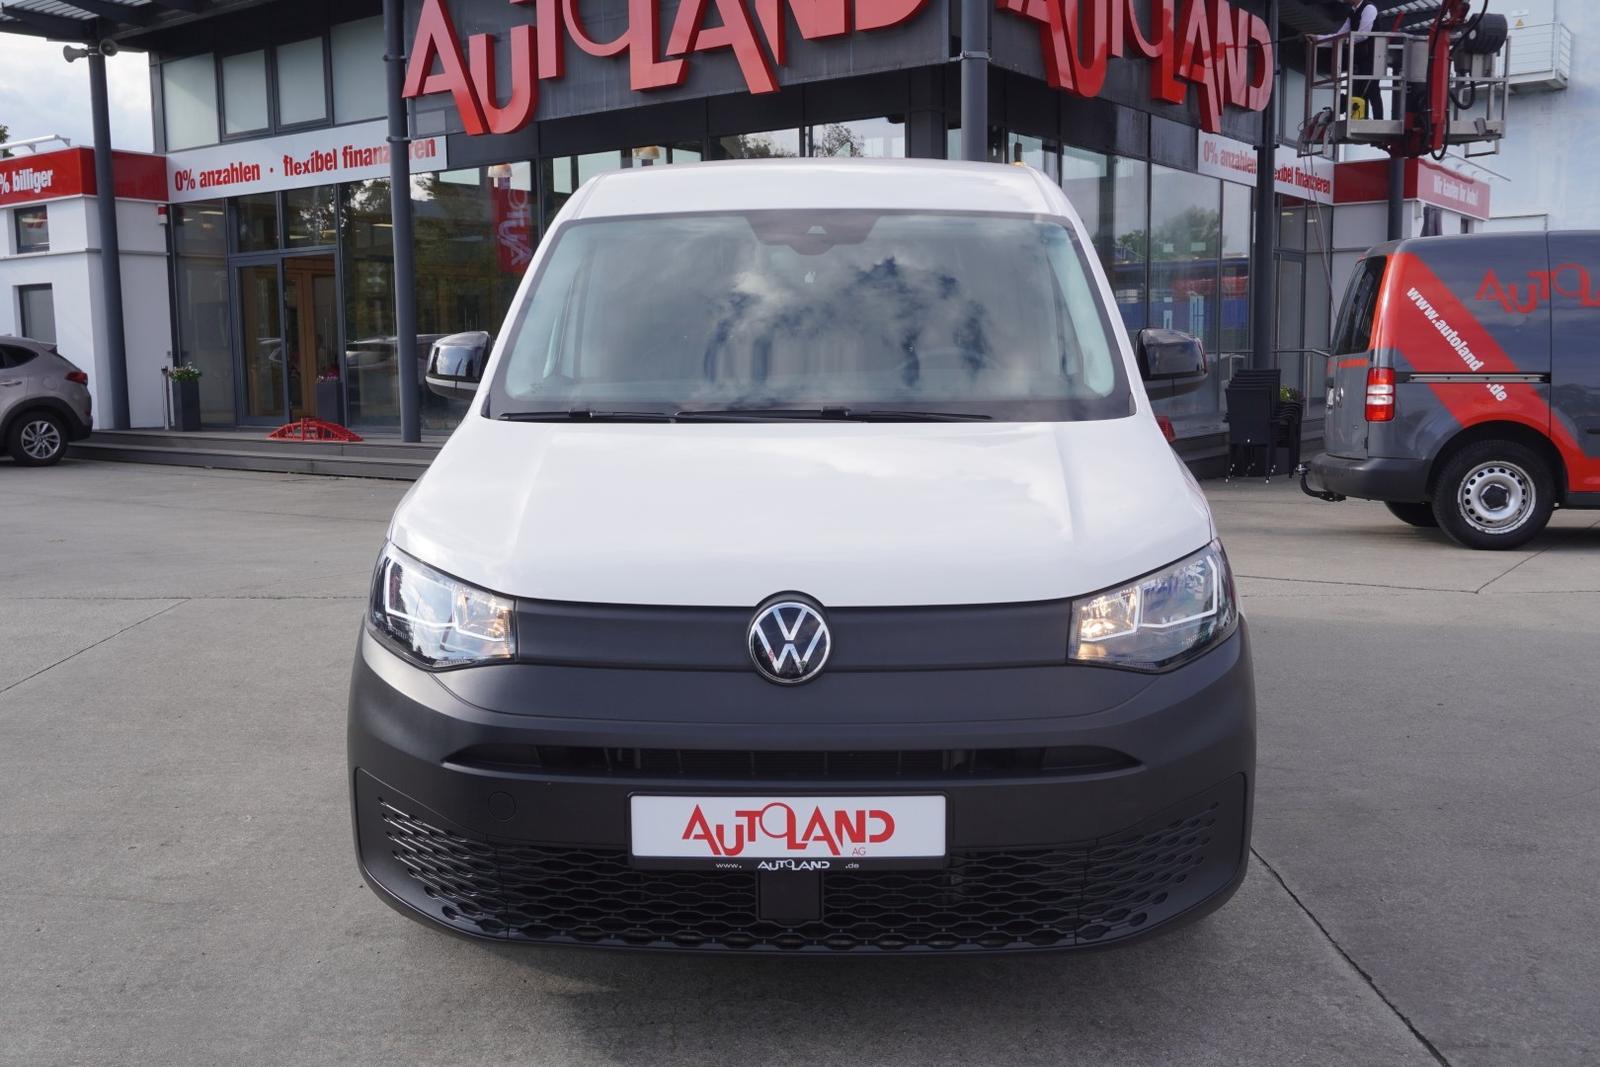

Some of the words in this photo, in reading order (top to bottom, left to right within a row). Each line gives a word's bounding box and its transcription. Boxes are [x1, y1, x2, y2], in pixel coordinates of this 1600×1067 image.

[402, 0, 926, 135] AUTOLA
[12, 168, 53, 193] billiger
[175, 168, 196, 192] 0%
[199, 161, 261, 188] anzahlen
[283, 148, 338, 177] flexibel
[342, 138, 437, 169] finanzren
[1203, 140, 1218, 166] 0%
[1274, 163, 1294, 185] exibel
[1474, 262, 1600, 314] AUTOL
[1407, 287, 1484, 372] www.autoland
[1486, 383, 1507, 401] .de
[681, 802, 895, 856] AUTOLAND
[851, 847, 866, 856] AG
[757, 859, 830, 871] AUTOLAND
